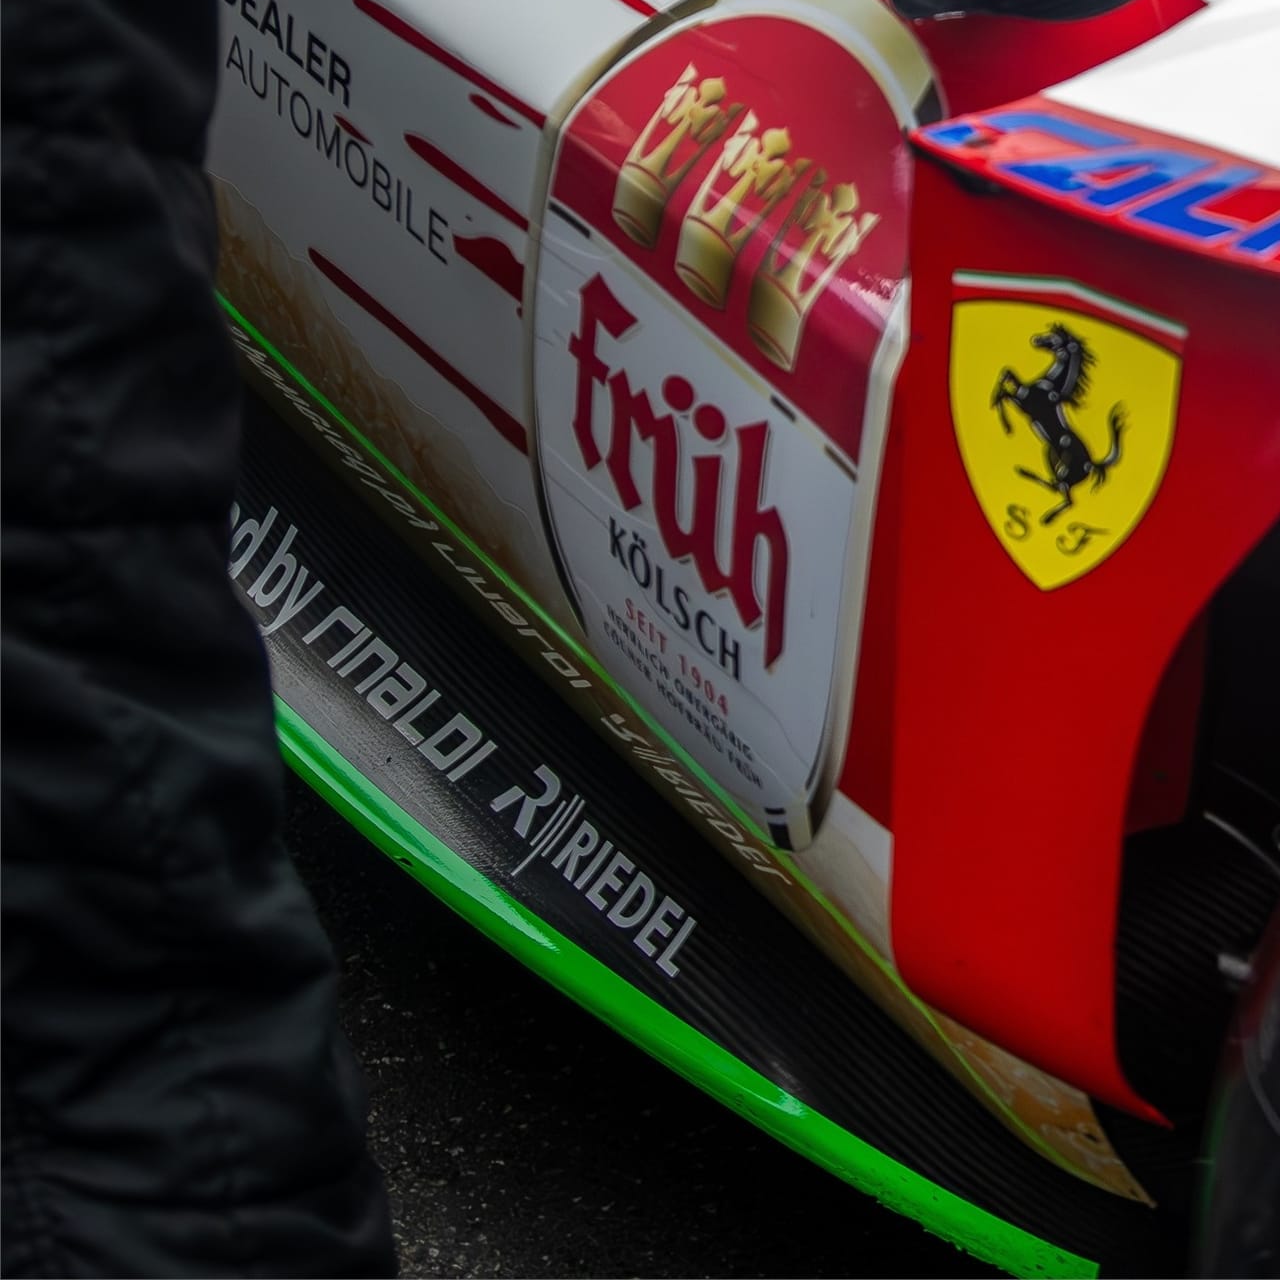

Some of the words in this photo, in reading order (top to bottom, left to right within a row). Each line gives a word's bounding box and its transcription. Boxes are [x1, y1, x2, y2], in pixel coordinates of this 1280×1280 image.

[225, 34, 450, 266] AUTOMOBILE
[608, 515, 742, 683] KÖLSCH
[625, 597, 667, 655] SEIT
[678, 652, 729, 718] 1904
[246, 523, 326, 637] by
[550, 831, 698, 978] RIEDEL
